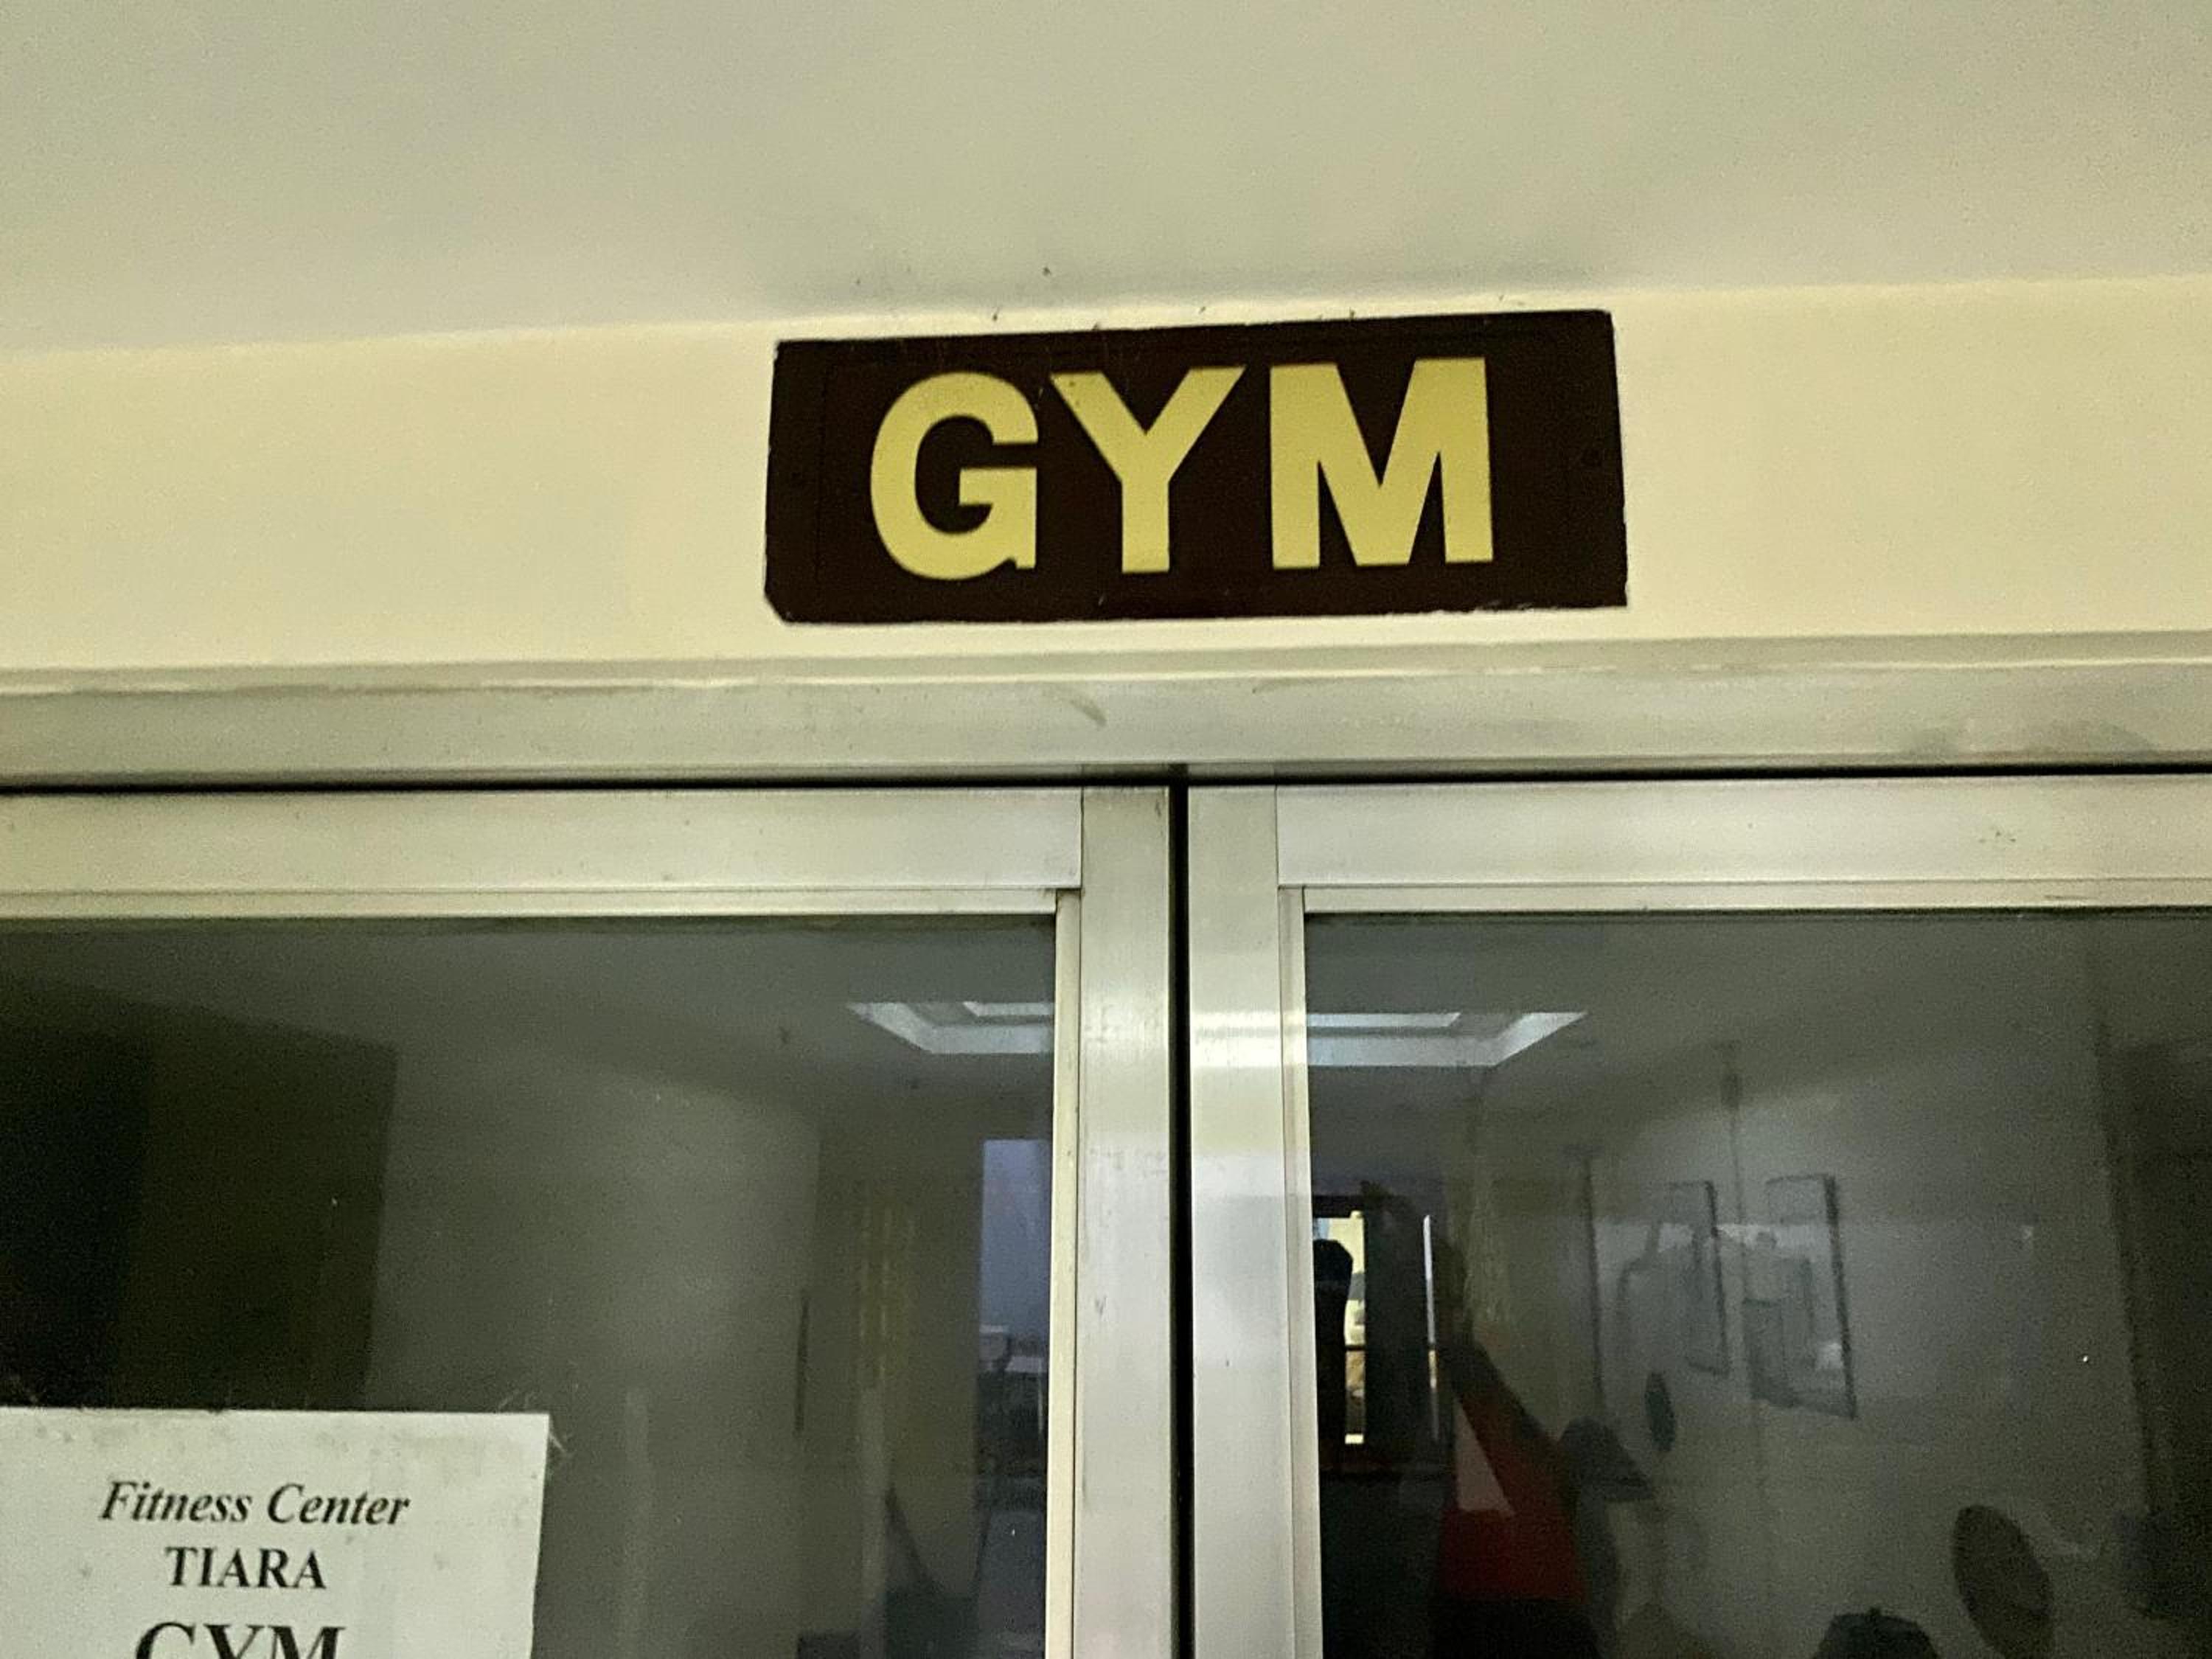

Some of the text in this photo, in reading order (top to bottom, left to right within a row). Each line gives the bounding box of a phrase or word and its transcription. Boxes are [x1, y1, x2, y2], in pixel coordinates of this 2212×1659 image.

[870, 357, 1495, 580] GYM
[100, 1481, 411, 1526] Fitness Center
[165, 1546, 327, 1590] TIARA
